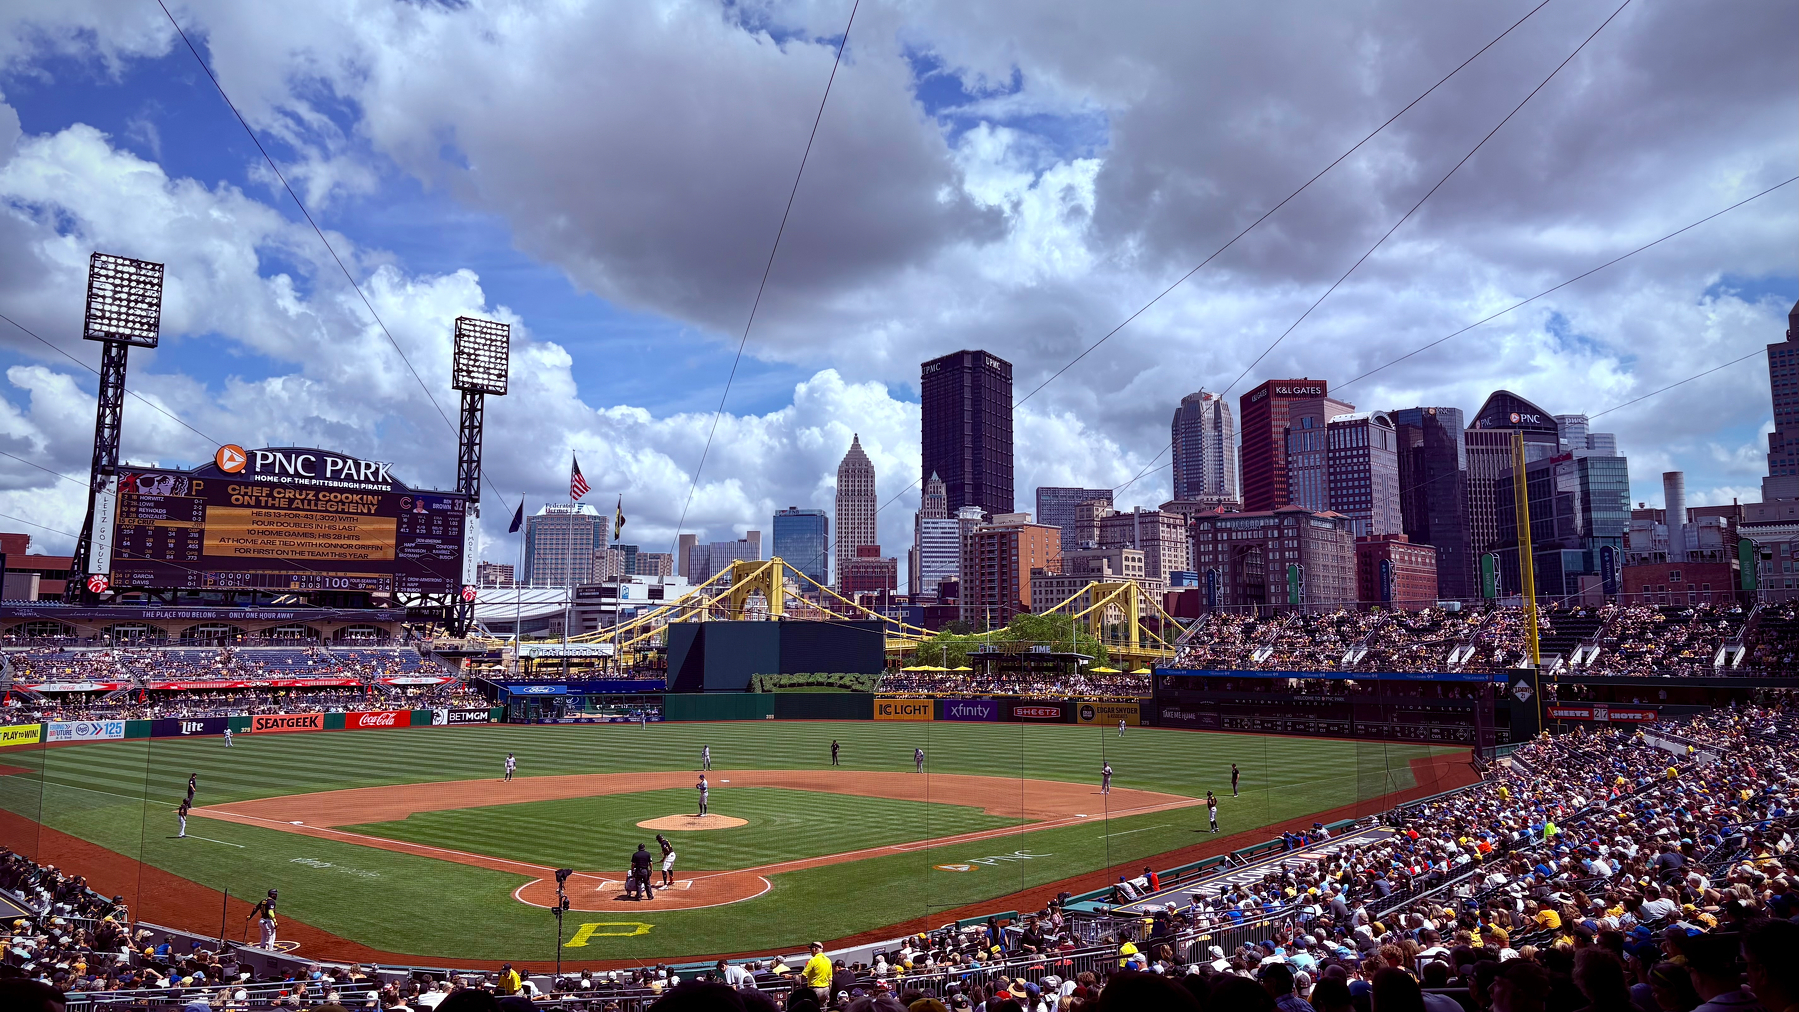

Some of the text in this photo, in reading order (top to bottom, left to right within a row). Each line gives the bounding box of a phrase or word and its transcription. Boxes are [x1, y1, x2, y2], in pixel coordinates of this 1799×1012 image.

[986, 356, 1000, 370] UPMC
[922, 363, 940, 375] UPMC
[1258, 389, 1267, 399] GATES
[1481, 417, 1492, 427] PNC
[1520, 414, 1540, 423] PNC
[253, 450, 394, 483] PNC PARK
[192, 480, 204, 495] P
[312, 480, 358, 489] PITTSBURGH
[361, 483, 391, 491] PIRATES
[228, 485, 382, 504] CHEF CRUZ COOKIN'
[231, 495, 378, 514] ON THE ALLEGHENY
[454, 499, 463, 510] 32
[315, 514, 337, 522] (.302)
[276, 521, 314, 529] DOUBLES
[100, 527, 105, 540] GO
[284, 531, 317, 539] GAMES;
[325, 577, 349, 588] 100
[156, 611, 176, 619] PLACE
[229, 612, 245, 620] ONLY
[879, 704, 928, 715] IC LIGHT
[951, 704, 990, 718] xfinity
[1162, 710, 1173, 718] TAKE
[359, 713, 397, 726] Coca-Cola
[450, 711, 488, 720] BETMGM
[105, 723, 122, 734] 125
[181, 721, 203, 734] Lite
[256, 716, 319, 730] SEATGEEK
[3, 729, 38, 740] PLAY WIN!
[965, 850, 1052, 866] PNC
[563, 922, 655, 947] P
